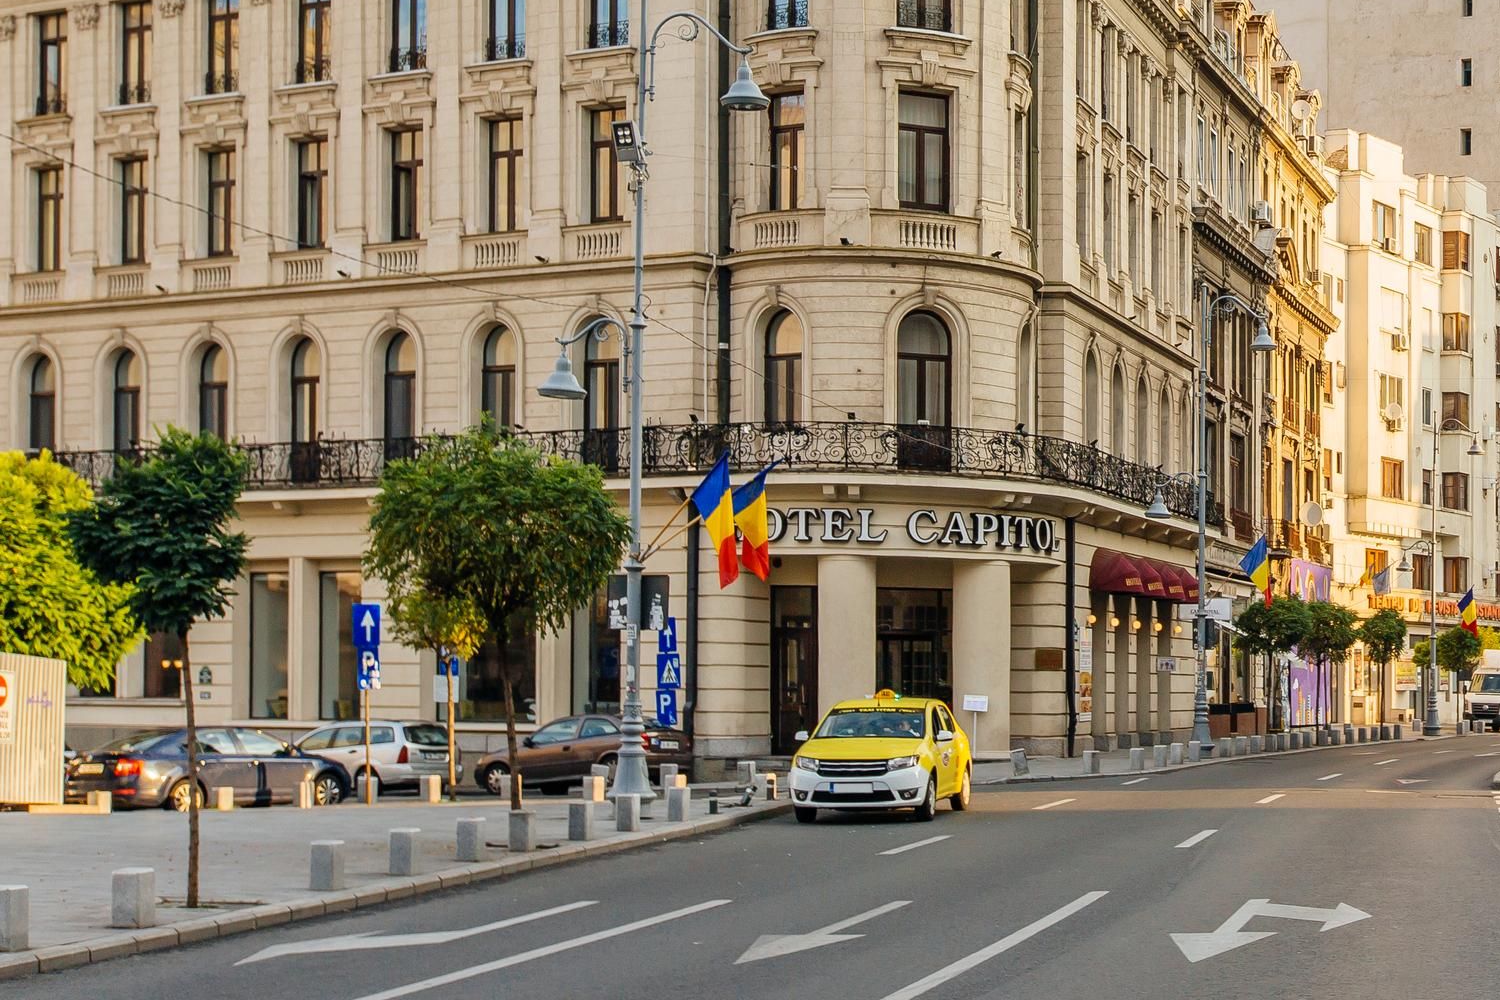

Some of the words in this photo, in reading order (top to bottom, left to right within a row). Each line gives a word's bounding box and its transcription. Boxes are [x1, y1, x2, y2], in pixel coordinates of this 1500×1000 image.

[735, 508, 888, 543] OTEL
[907, 509, 1060, 552] CAPITOL
[660, 694, 672, 715] P
